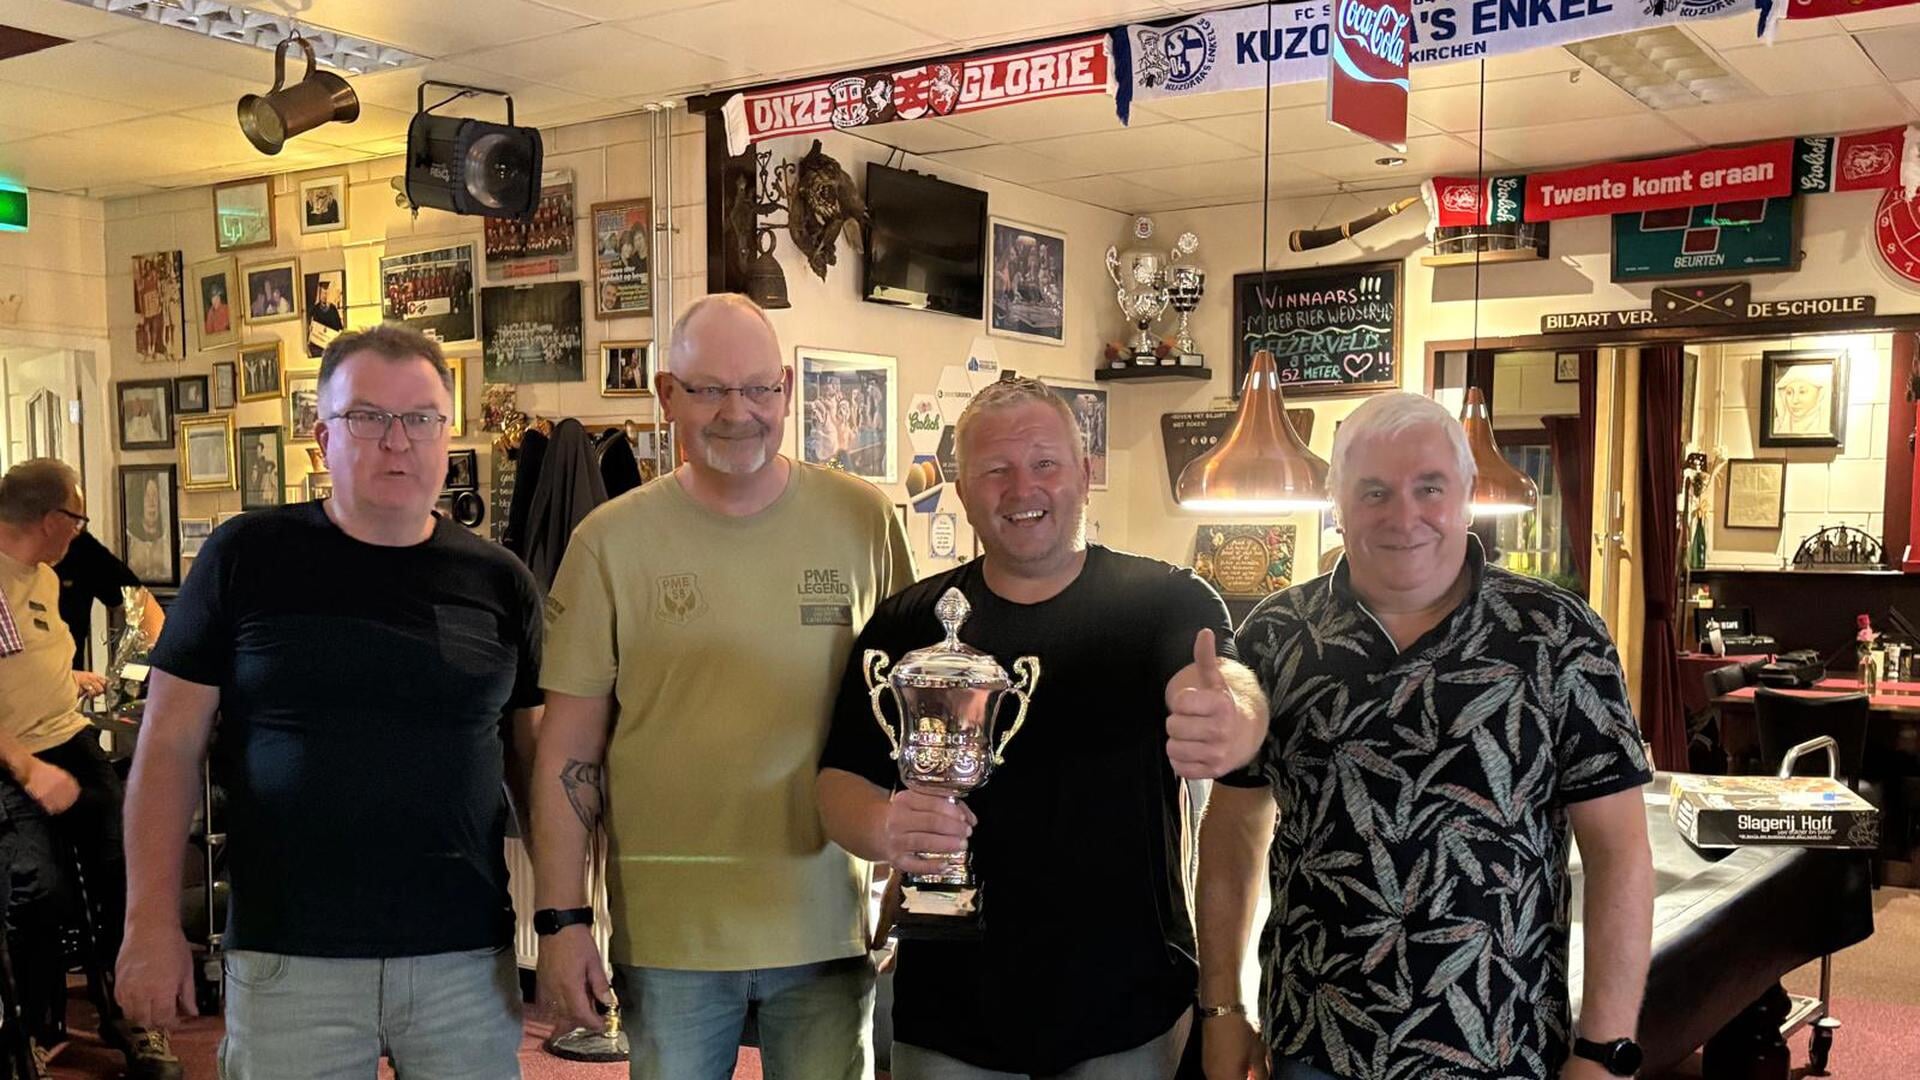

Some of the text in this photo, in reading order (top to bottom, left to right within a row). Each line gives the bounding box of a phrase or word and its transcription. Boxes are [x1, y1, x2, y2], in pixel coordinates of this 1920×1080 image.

[1295, 7, 1315, 21] FC
[753, 46, 1095, 133] ONZE GLORIE
[1802, 136, 1829, 190] Grolsch
[1540, 162, 1775, 207] Twente komt eraan
[1881, 216, 1889, 227] 9
[1887, 242, 1896, 255] 8
[1673, 254, 1725, 269] BEURTEN
[1747, 297, 1865, 317] DE SCHOLLE
[1546, 310, 1658, 329] BILJART VER.
[1281, 364, 1343, 382] 52 METER
[662, 577, 690, 588] PME
[804, 569, 839, 583] PME
[797, 583, 850, 594] LEGEND
[1738, 814, 1833, 832] Slagerij Hoff
